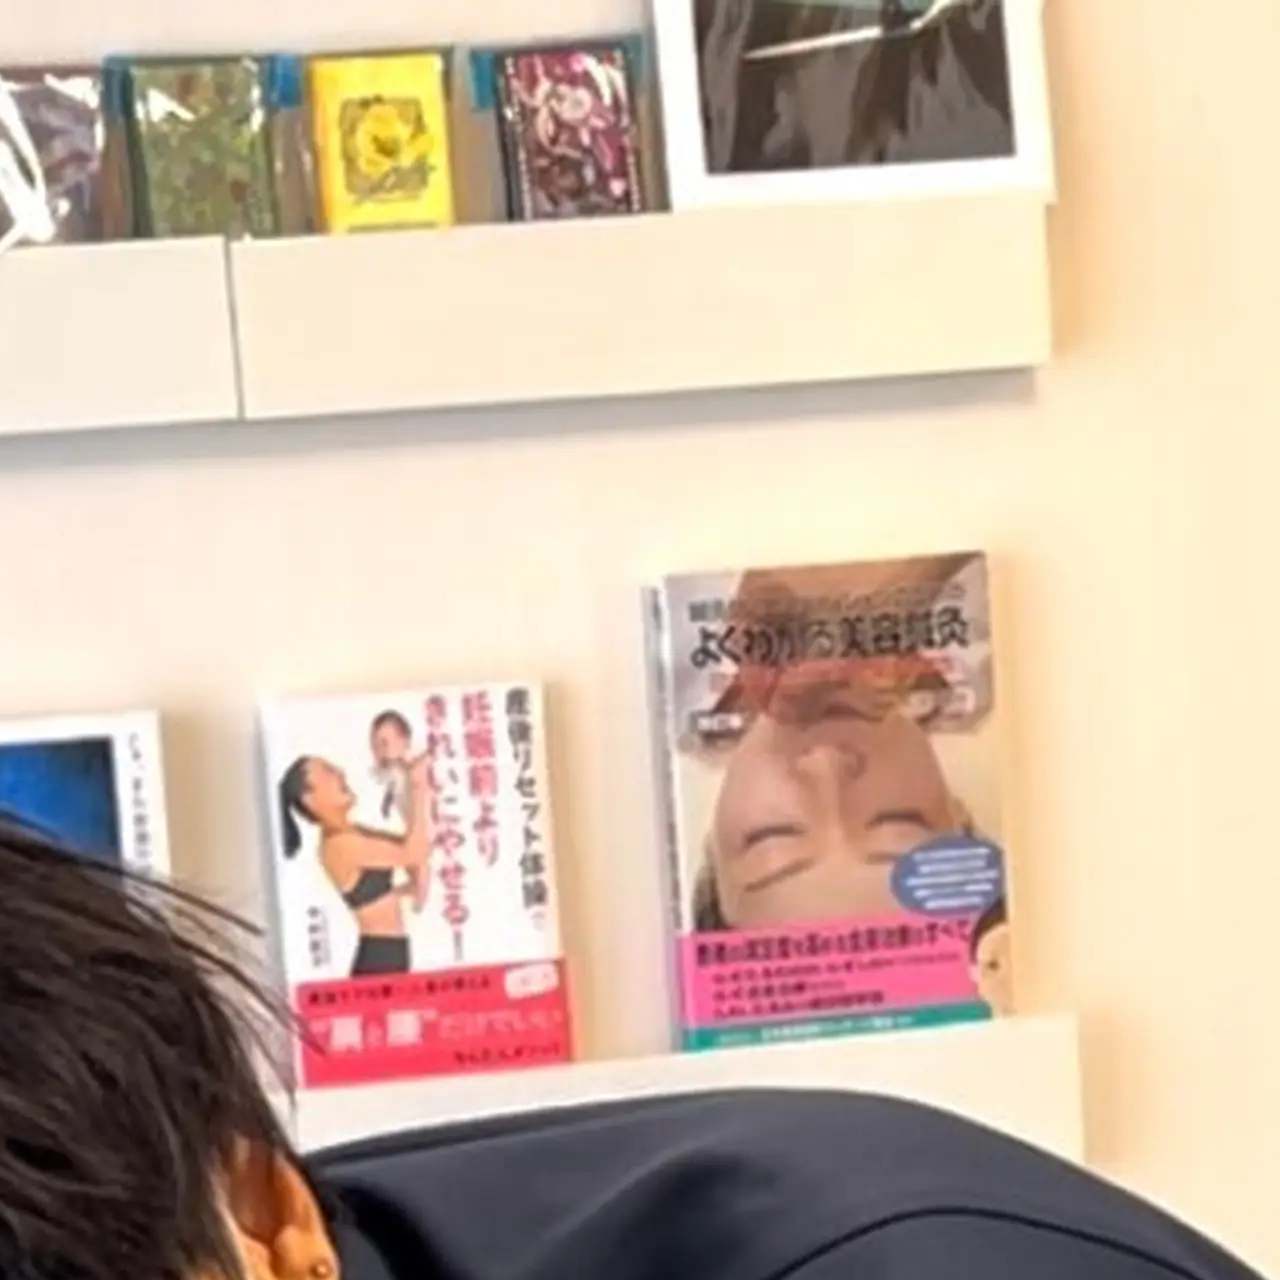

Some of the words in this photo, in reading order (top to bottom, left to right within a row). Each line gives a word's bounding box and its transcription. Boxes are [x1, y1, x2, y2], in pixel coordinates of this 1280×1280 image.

[689, 604, 969, 669] よくわかる美容鍼灸
[460, 691, 499, 866] 妊娠前より
